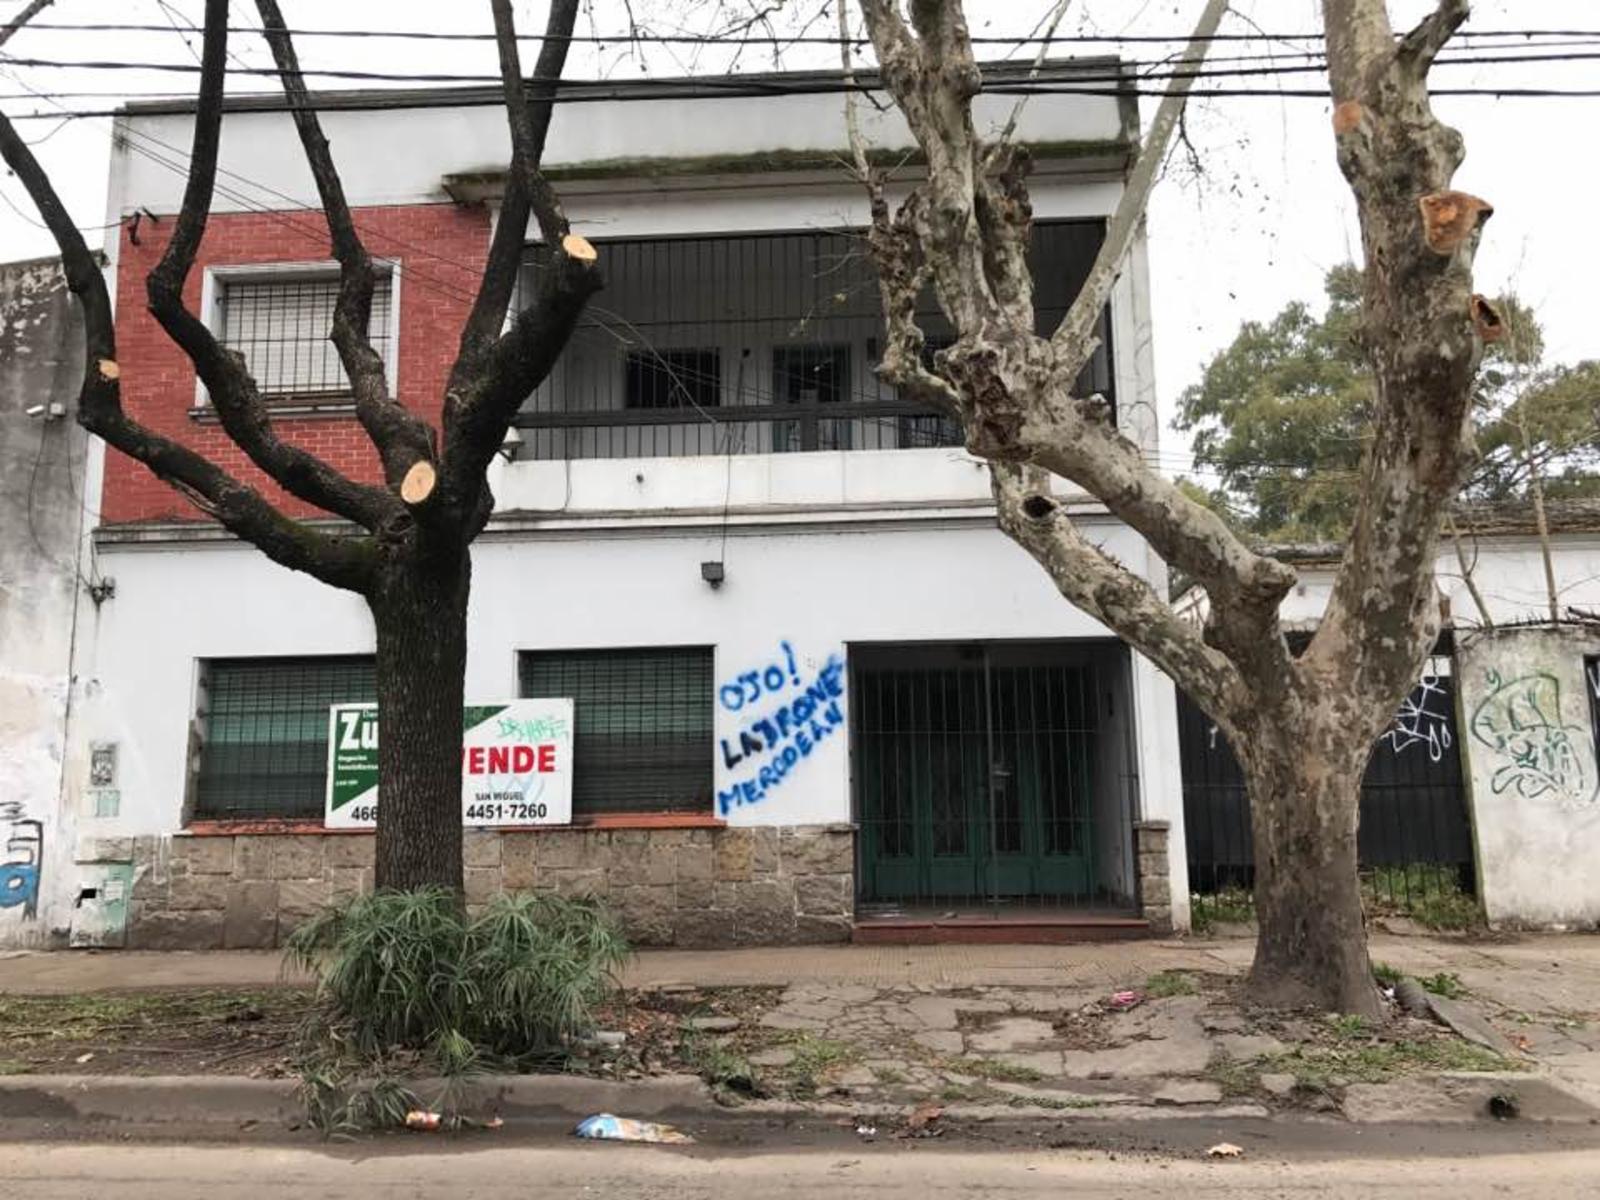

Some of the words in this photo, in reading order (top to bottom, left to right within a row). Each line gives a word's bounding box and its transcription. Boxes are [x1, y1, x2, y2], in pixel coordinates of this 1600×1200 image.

[720, 639, 801, 711] OJO!
[340, 712, 379, 750] Zu
[462, 745, 556, 775] ENDE
[351, 806, 379, 821] 466
[466, 803, 548, 819] 4451-7260
